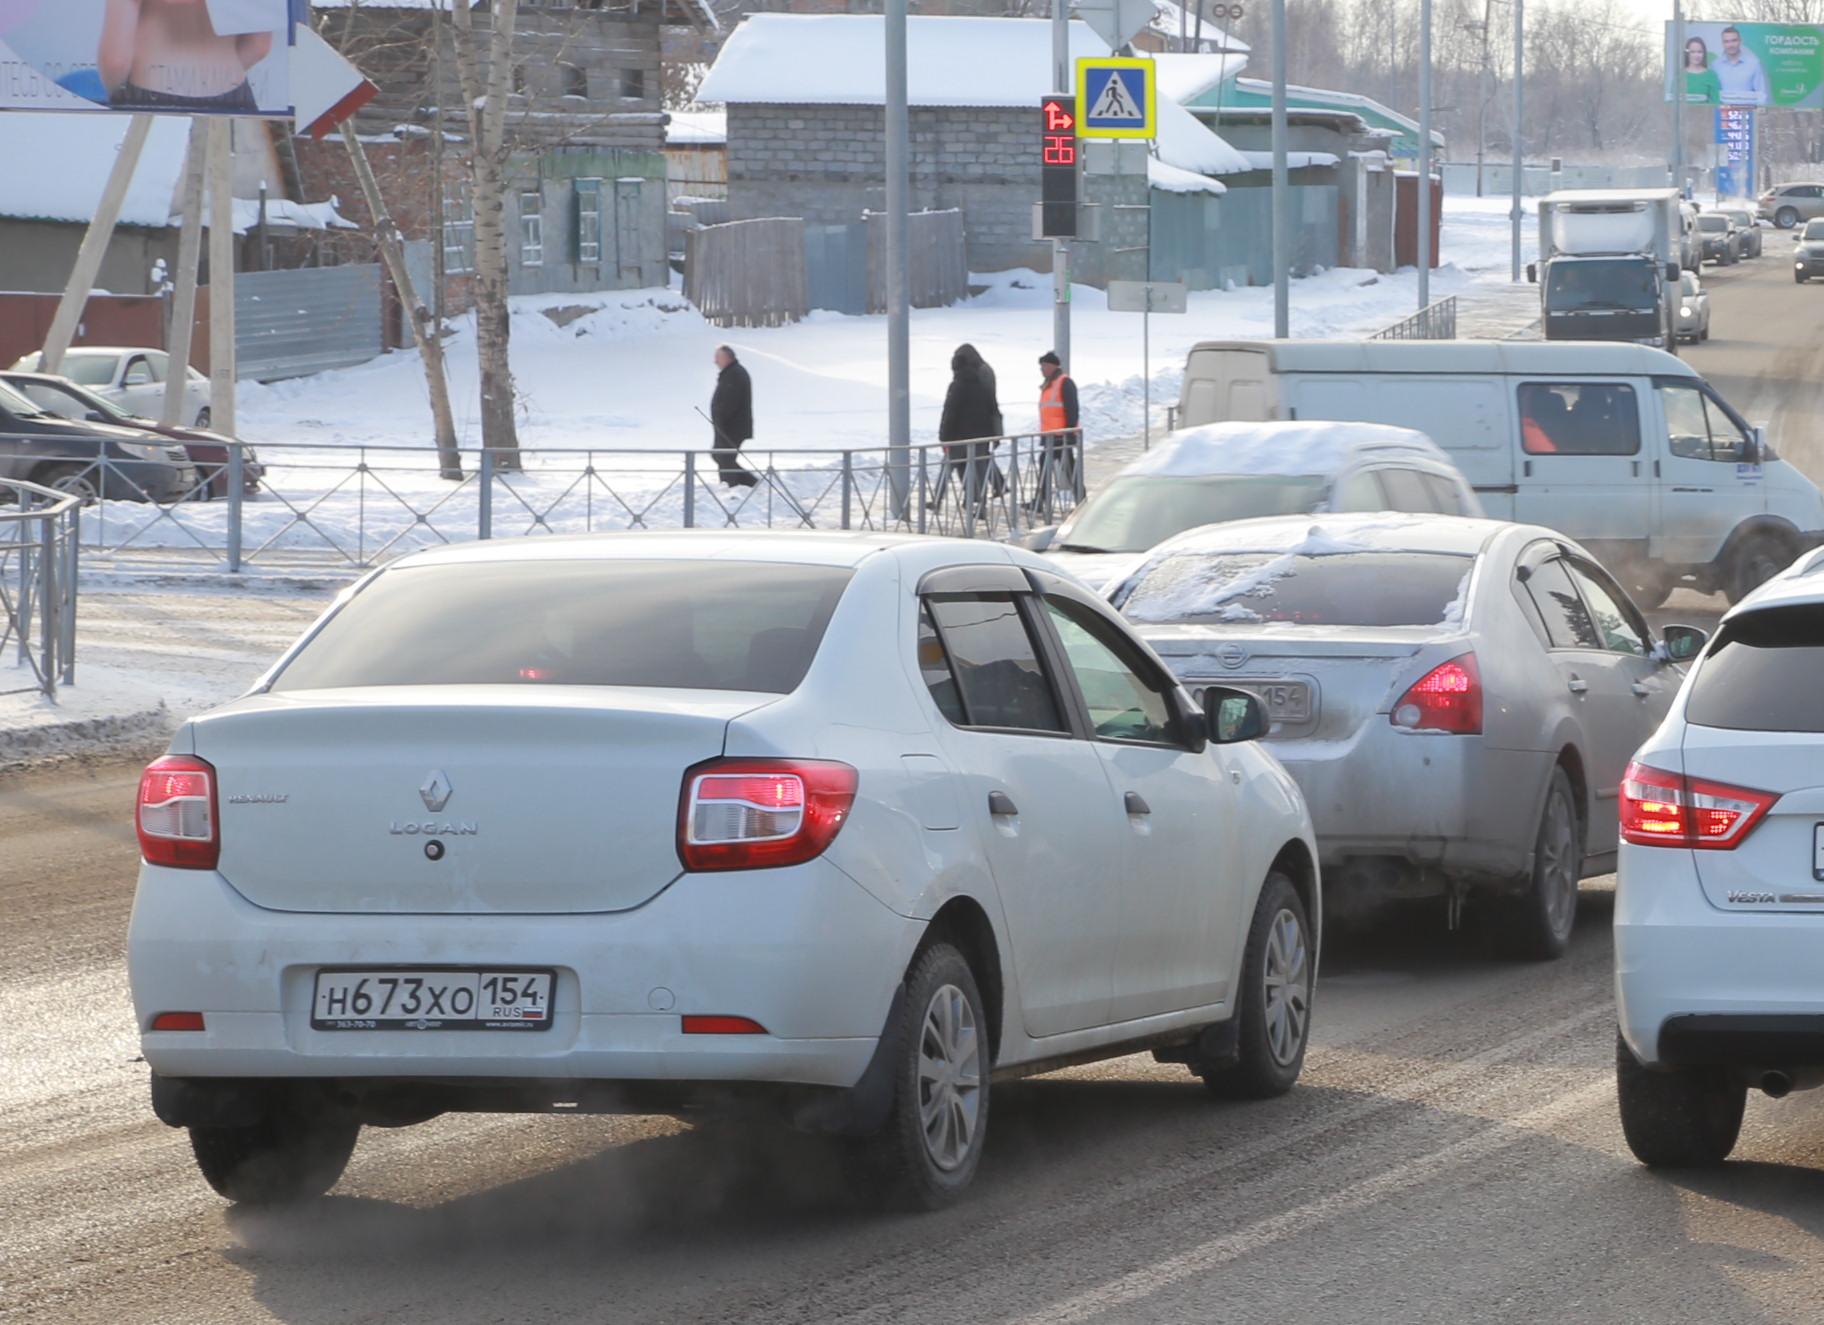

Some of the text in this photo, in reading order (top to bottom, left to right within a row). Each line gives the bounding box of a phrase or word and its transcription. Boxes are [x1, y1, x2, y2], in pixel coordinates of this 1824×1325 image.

[1044, 136, 1074, 164] 26
[390, 821, 478, 836] LOGAN
[483, 976, 538, 1006] 154
[493, 1007, 521, 1018] RUS
